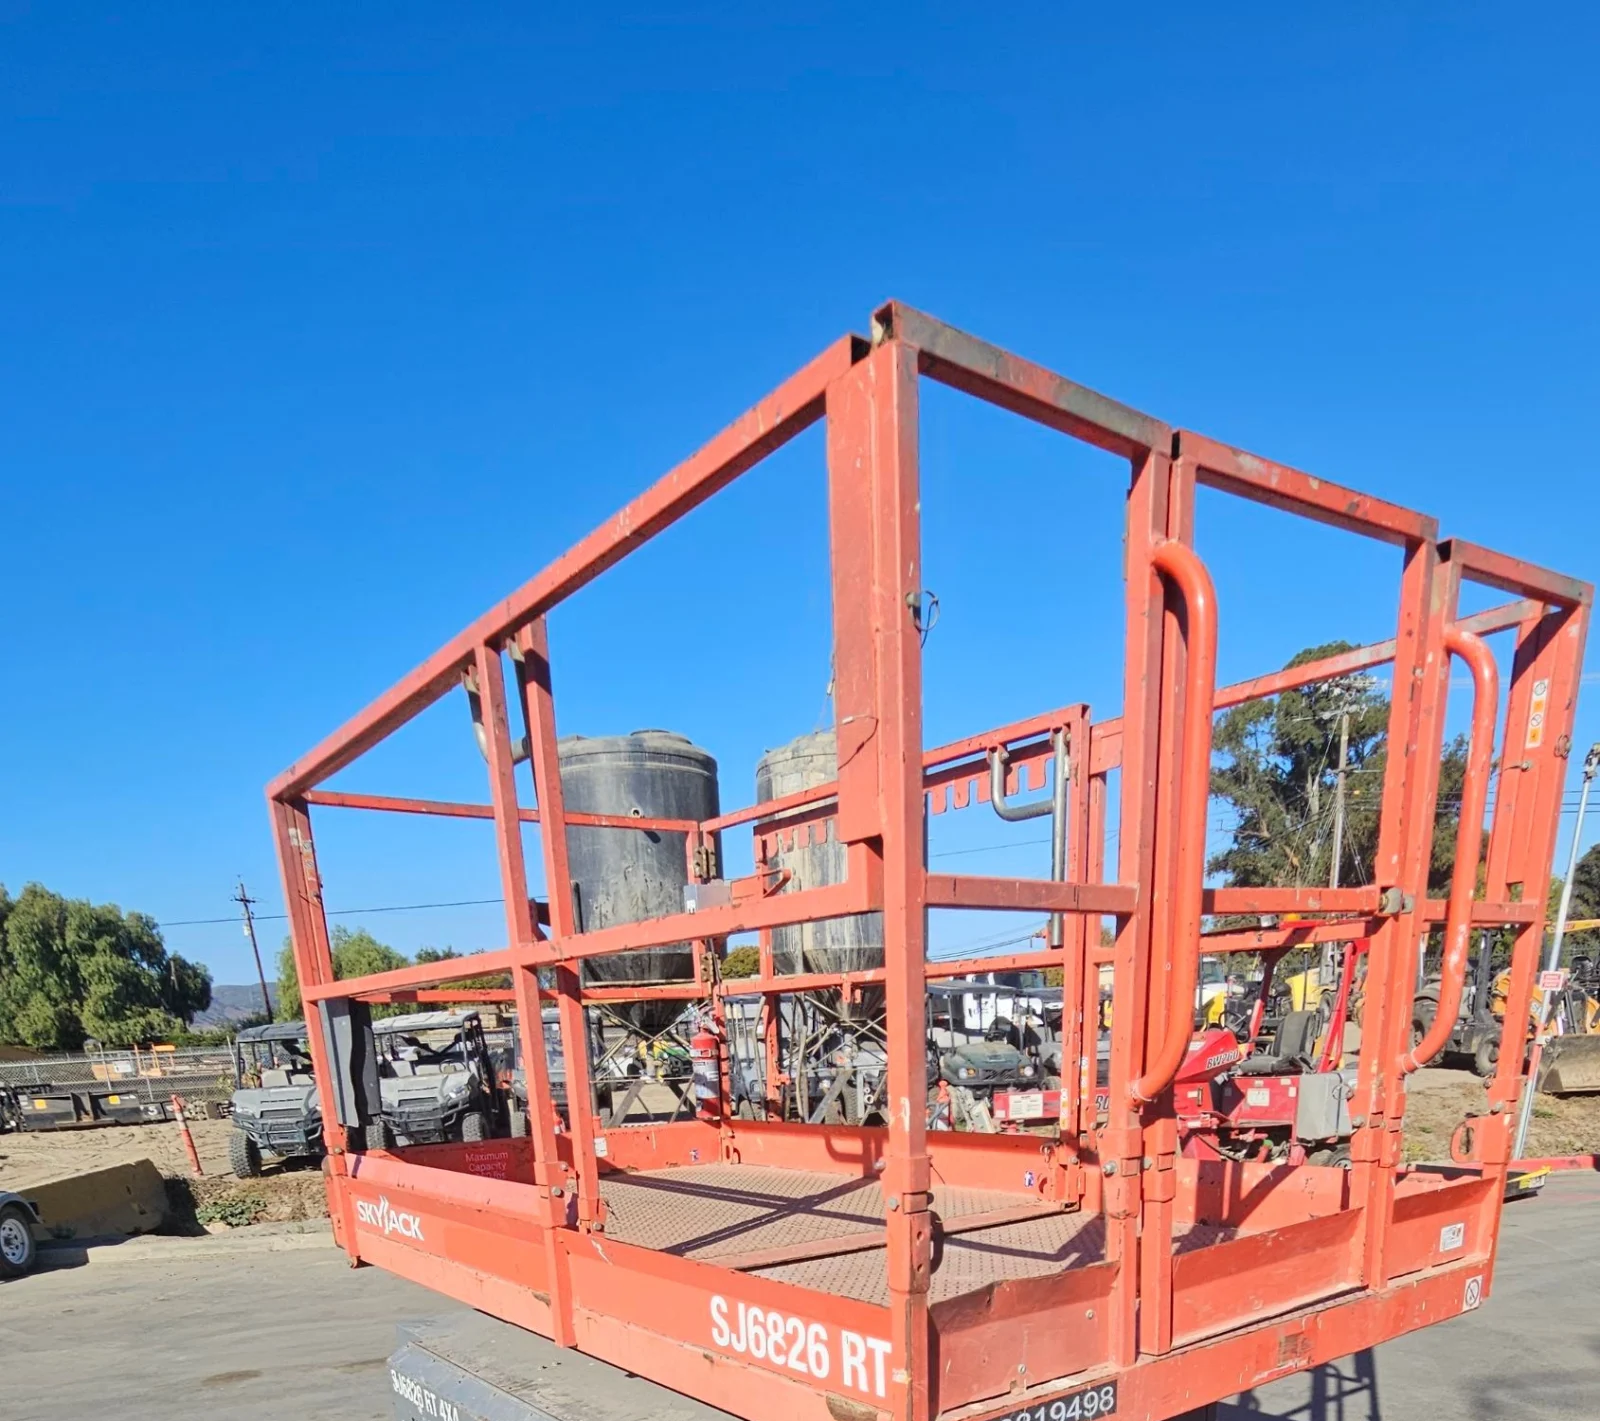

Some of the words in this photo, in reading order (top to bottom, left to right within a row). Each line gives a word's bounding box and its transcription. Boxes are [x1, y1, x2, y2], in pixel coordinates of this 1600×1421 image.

[465, 1151, 508, 1162] Maximum
[469, 1162, 506, 1173] Capacity
[357, 1194, 424, 1241] SKYJACK
[710, 1295, 830, 1379] SJ6826
[841, 1329, 892, 1398] RT
[390, 1369, 424, 1409] SJ6826
[423, 1389, 438, 1417] RT
